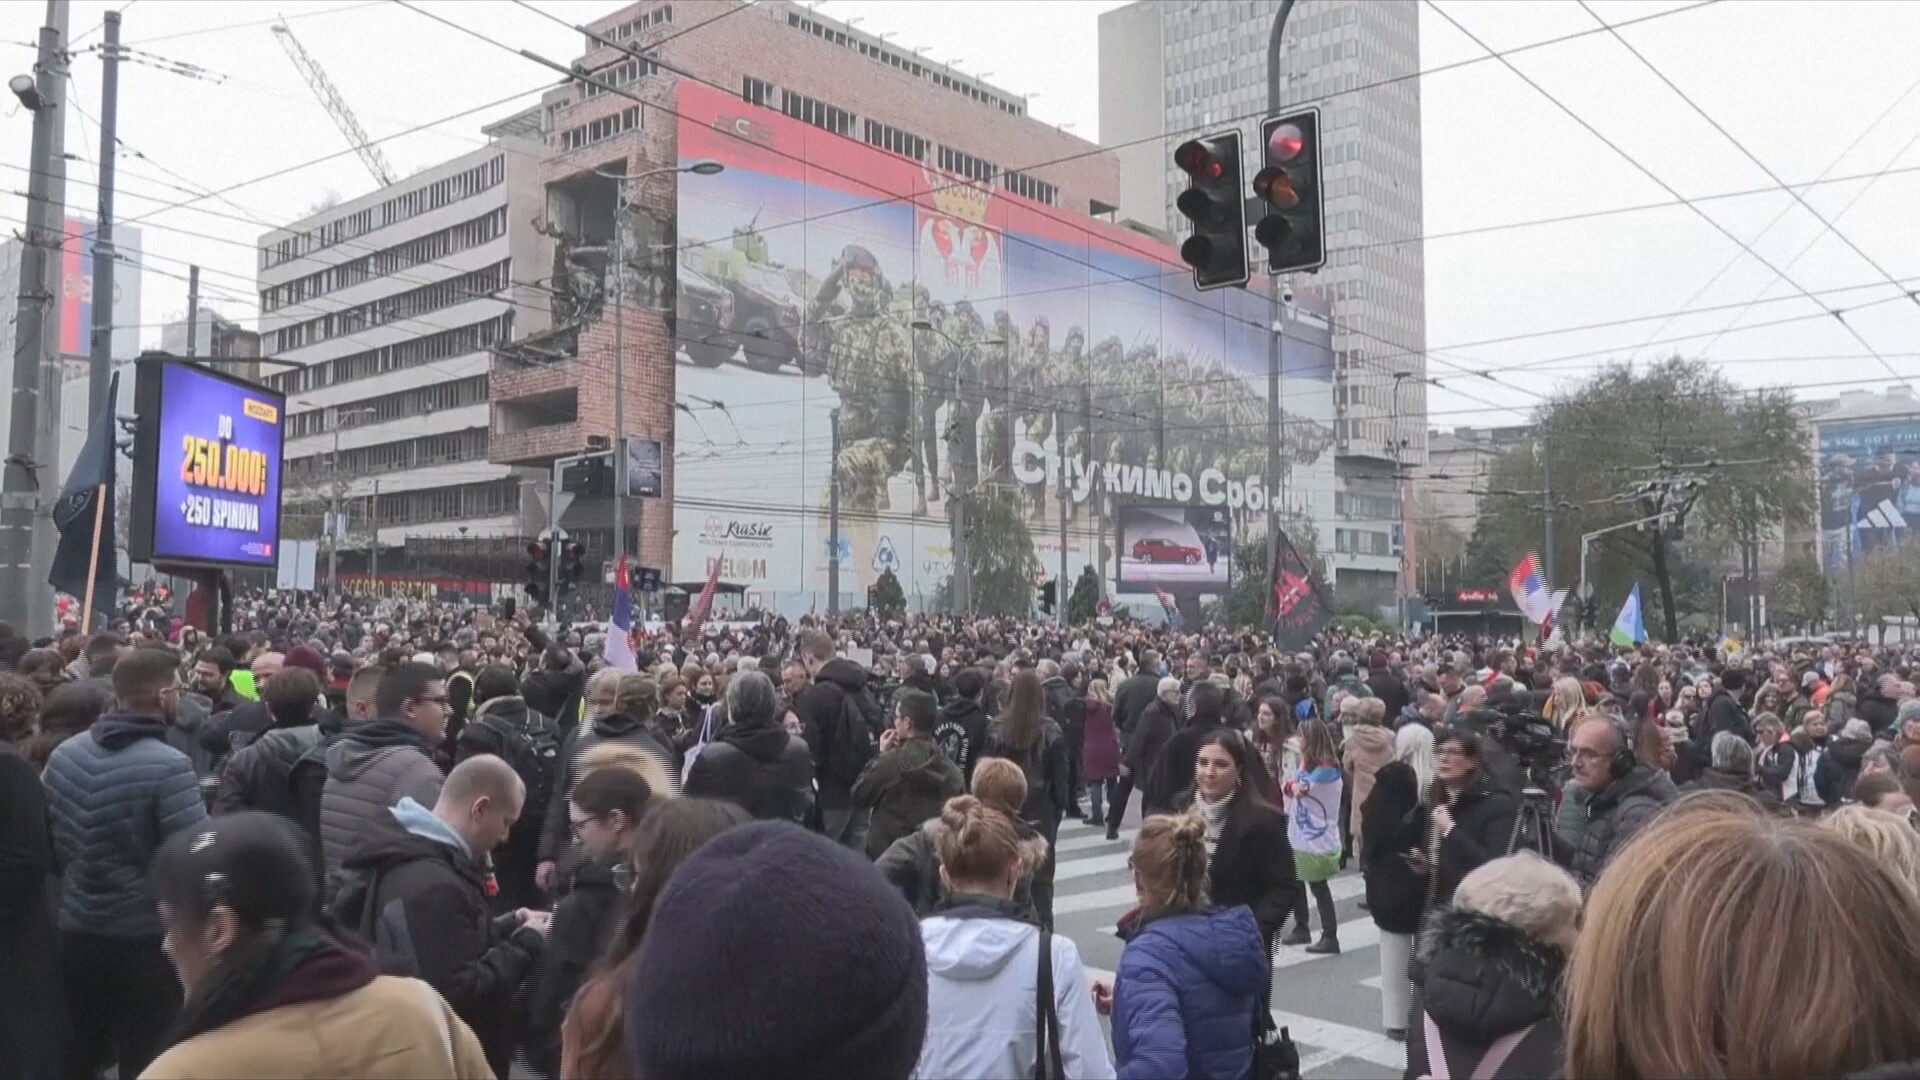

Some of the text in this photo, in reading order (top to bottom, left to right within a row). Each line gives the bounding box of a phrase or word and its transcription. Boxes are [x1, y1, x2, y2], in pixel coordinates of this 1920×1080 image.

[218, 415, 232, 439] DO
[180, 494, 259, 532] +250 SPINOVA
